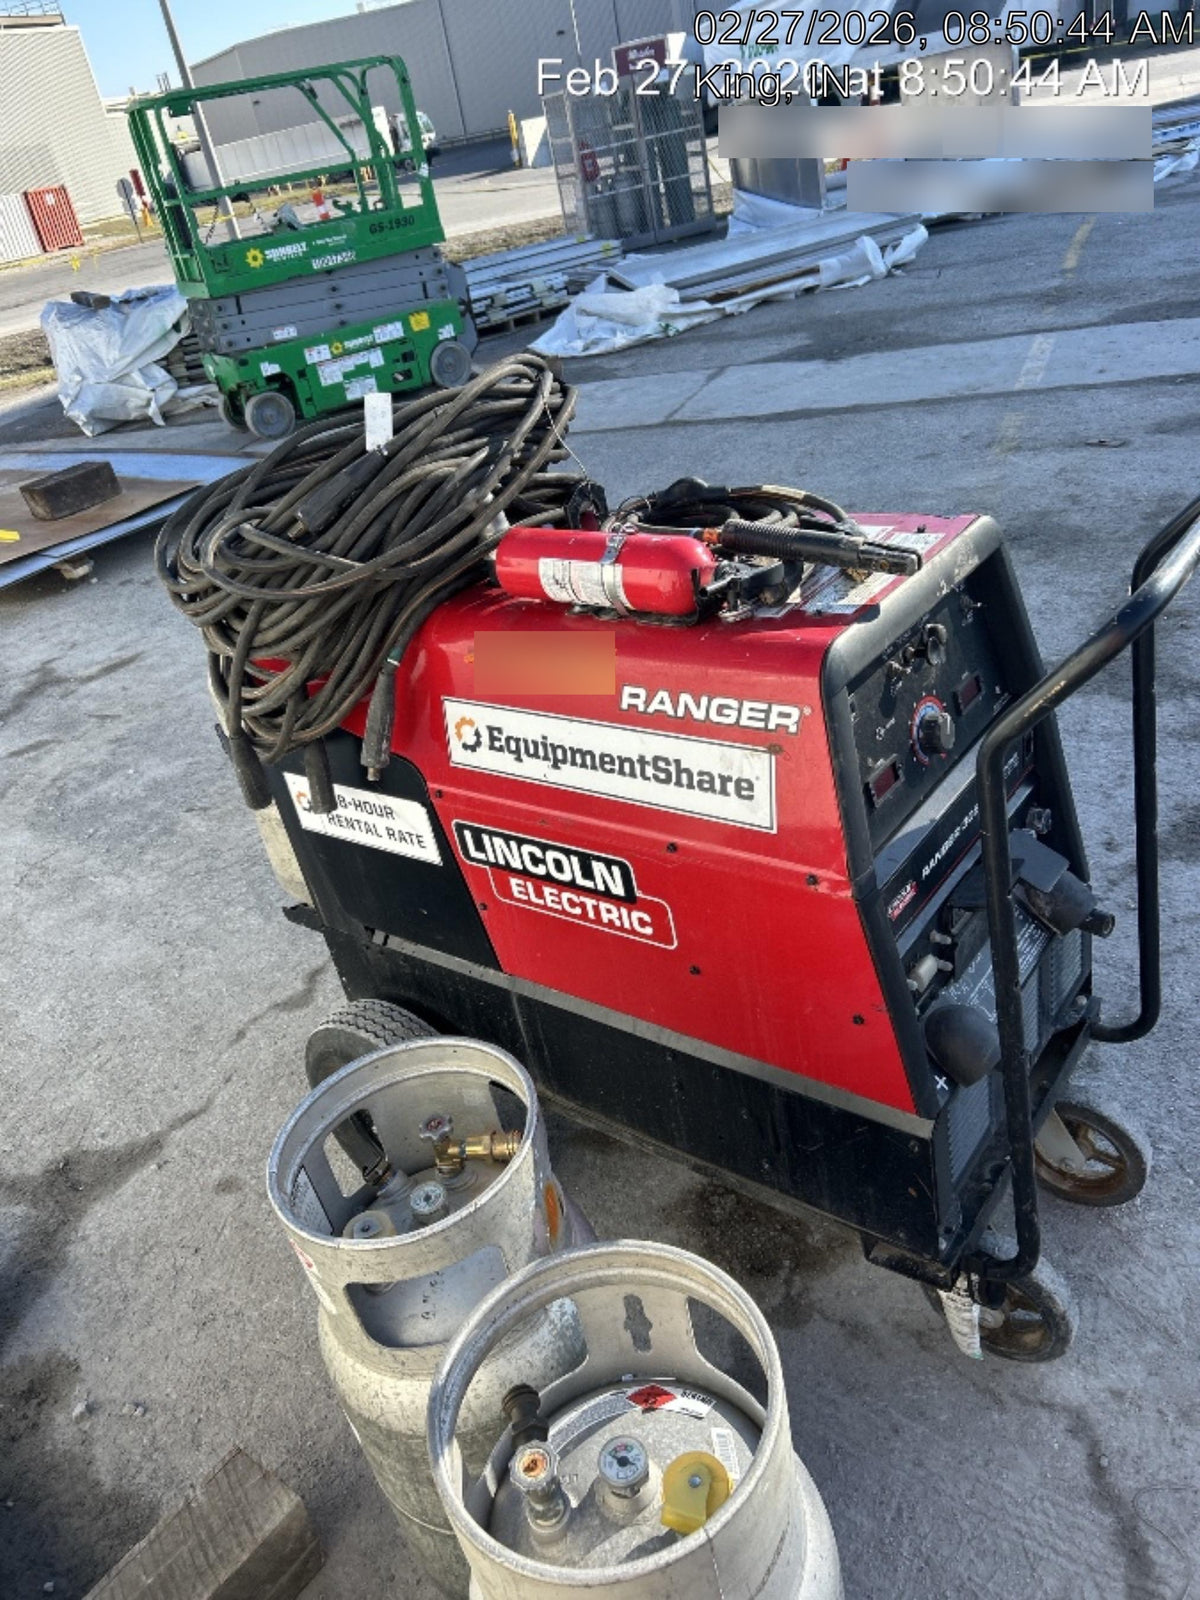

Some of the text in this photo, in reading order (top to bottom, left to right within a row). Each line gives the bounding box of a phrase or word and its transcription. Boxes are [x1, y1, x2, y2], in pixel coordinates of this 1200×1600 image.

[620, 684, 802, 735] RANGER
[486, 725, 756, 802] EquipmentShare
[327, 813, 427, 849] RENTAL RATE
[463, 829, 627, 898] LINCOLN
[509, 877, 654, 935] ELECTRIC
